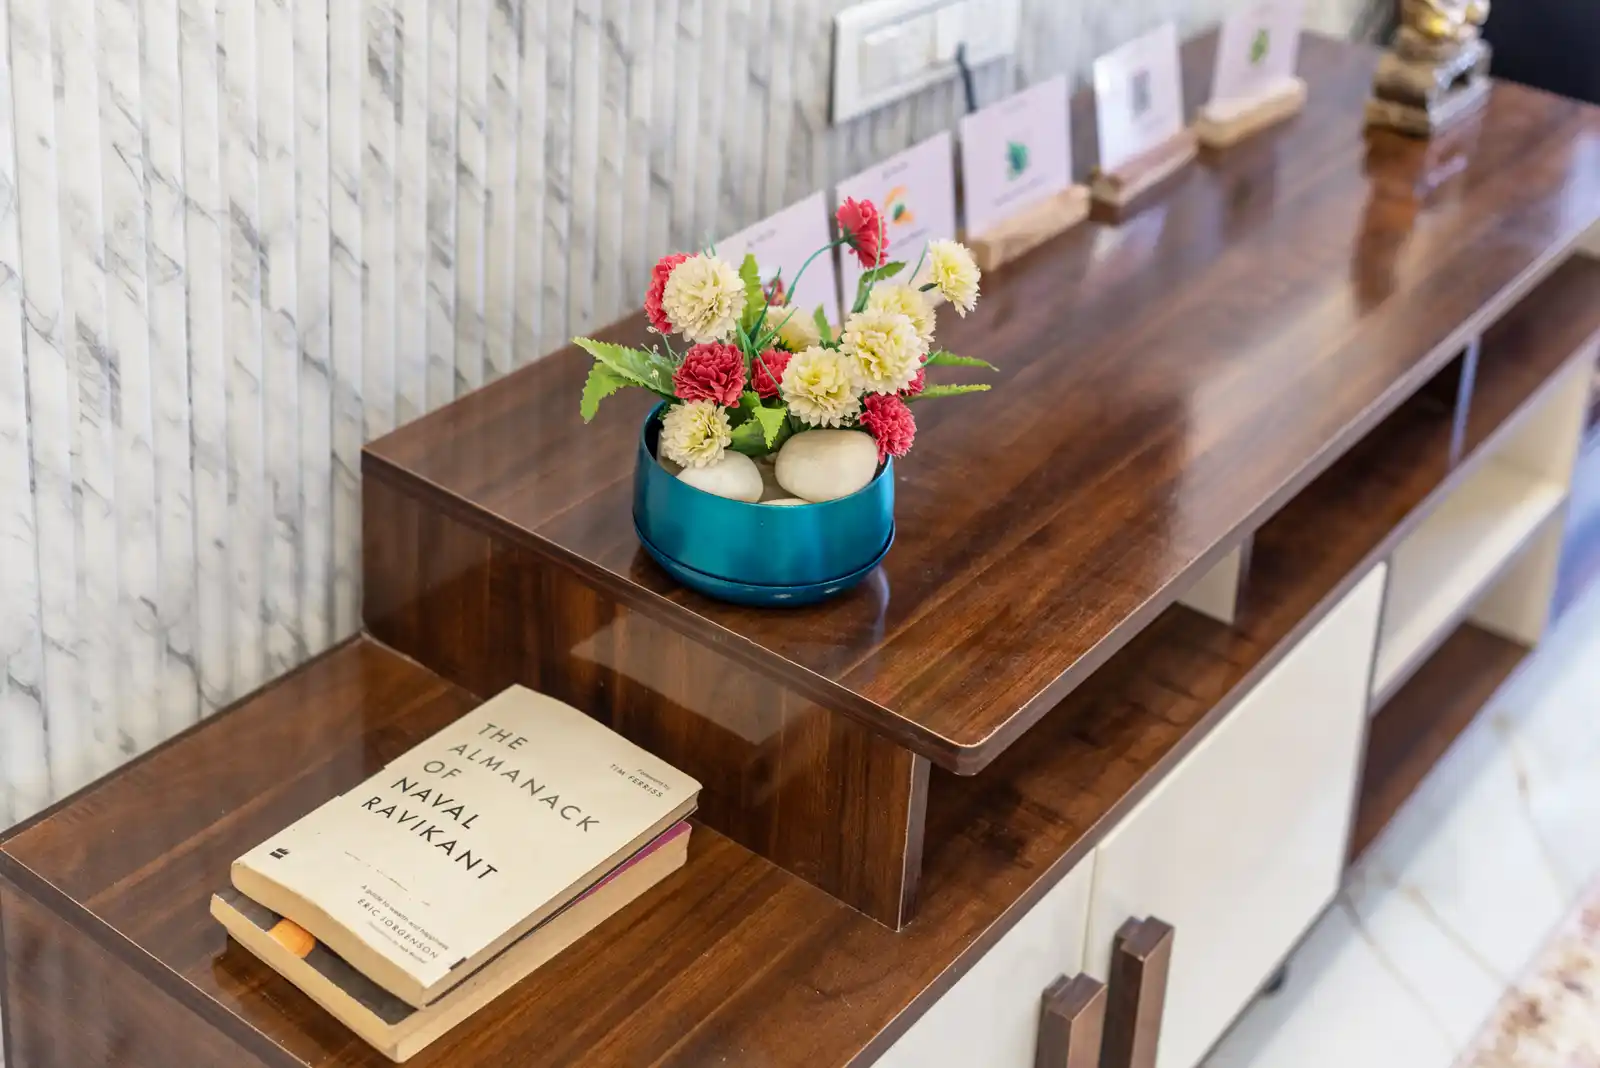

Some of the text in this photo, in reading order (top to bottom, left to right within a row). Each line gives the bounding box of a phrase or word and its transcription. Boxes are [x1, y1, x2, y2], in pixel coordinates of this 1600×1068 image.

[478, 723, 528, 750] THE
[423, 760, 462, 779] OF
[448, 744, 600, 832] ALMANACK
[627, 775, 664, 798] FERRISS
[390, 777, 479, 829] NAVAL
[361, 796, 498, 879] RAVIKANT
[382, 900, 390, 908] to
[357, 898, 381, 917] ERIC
[380, 916, 439, 959] JORGENSON
